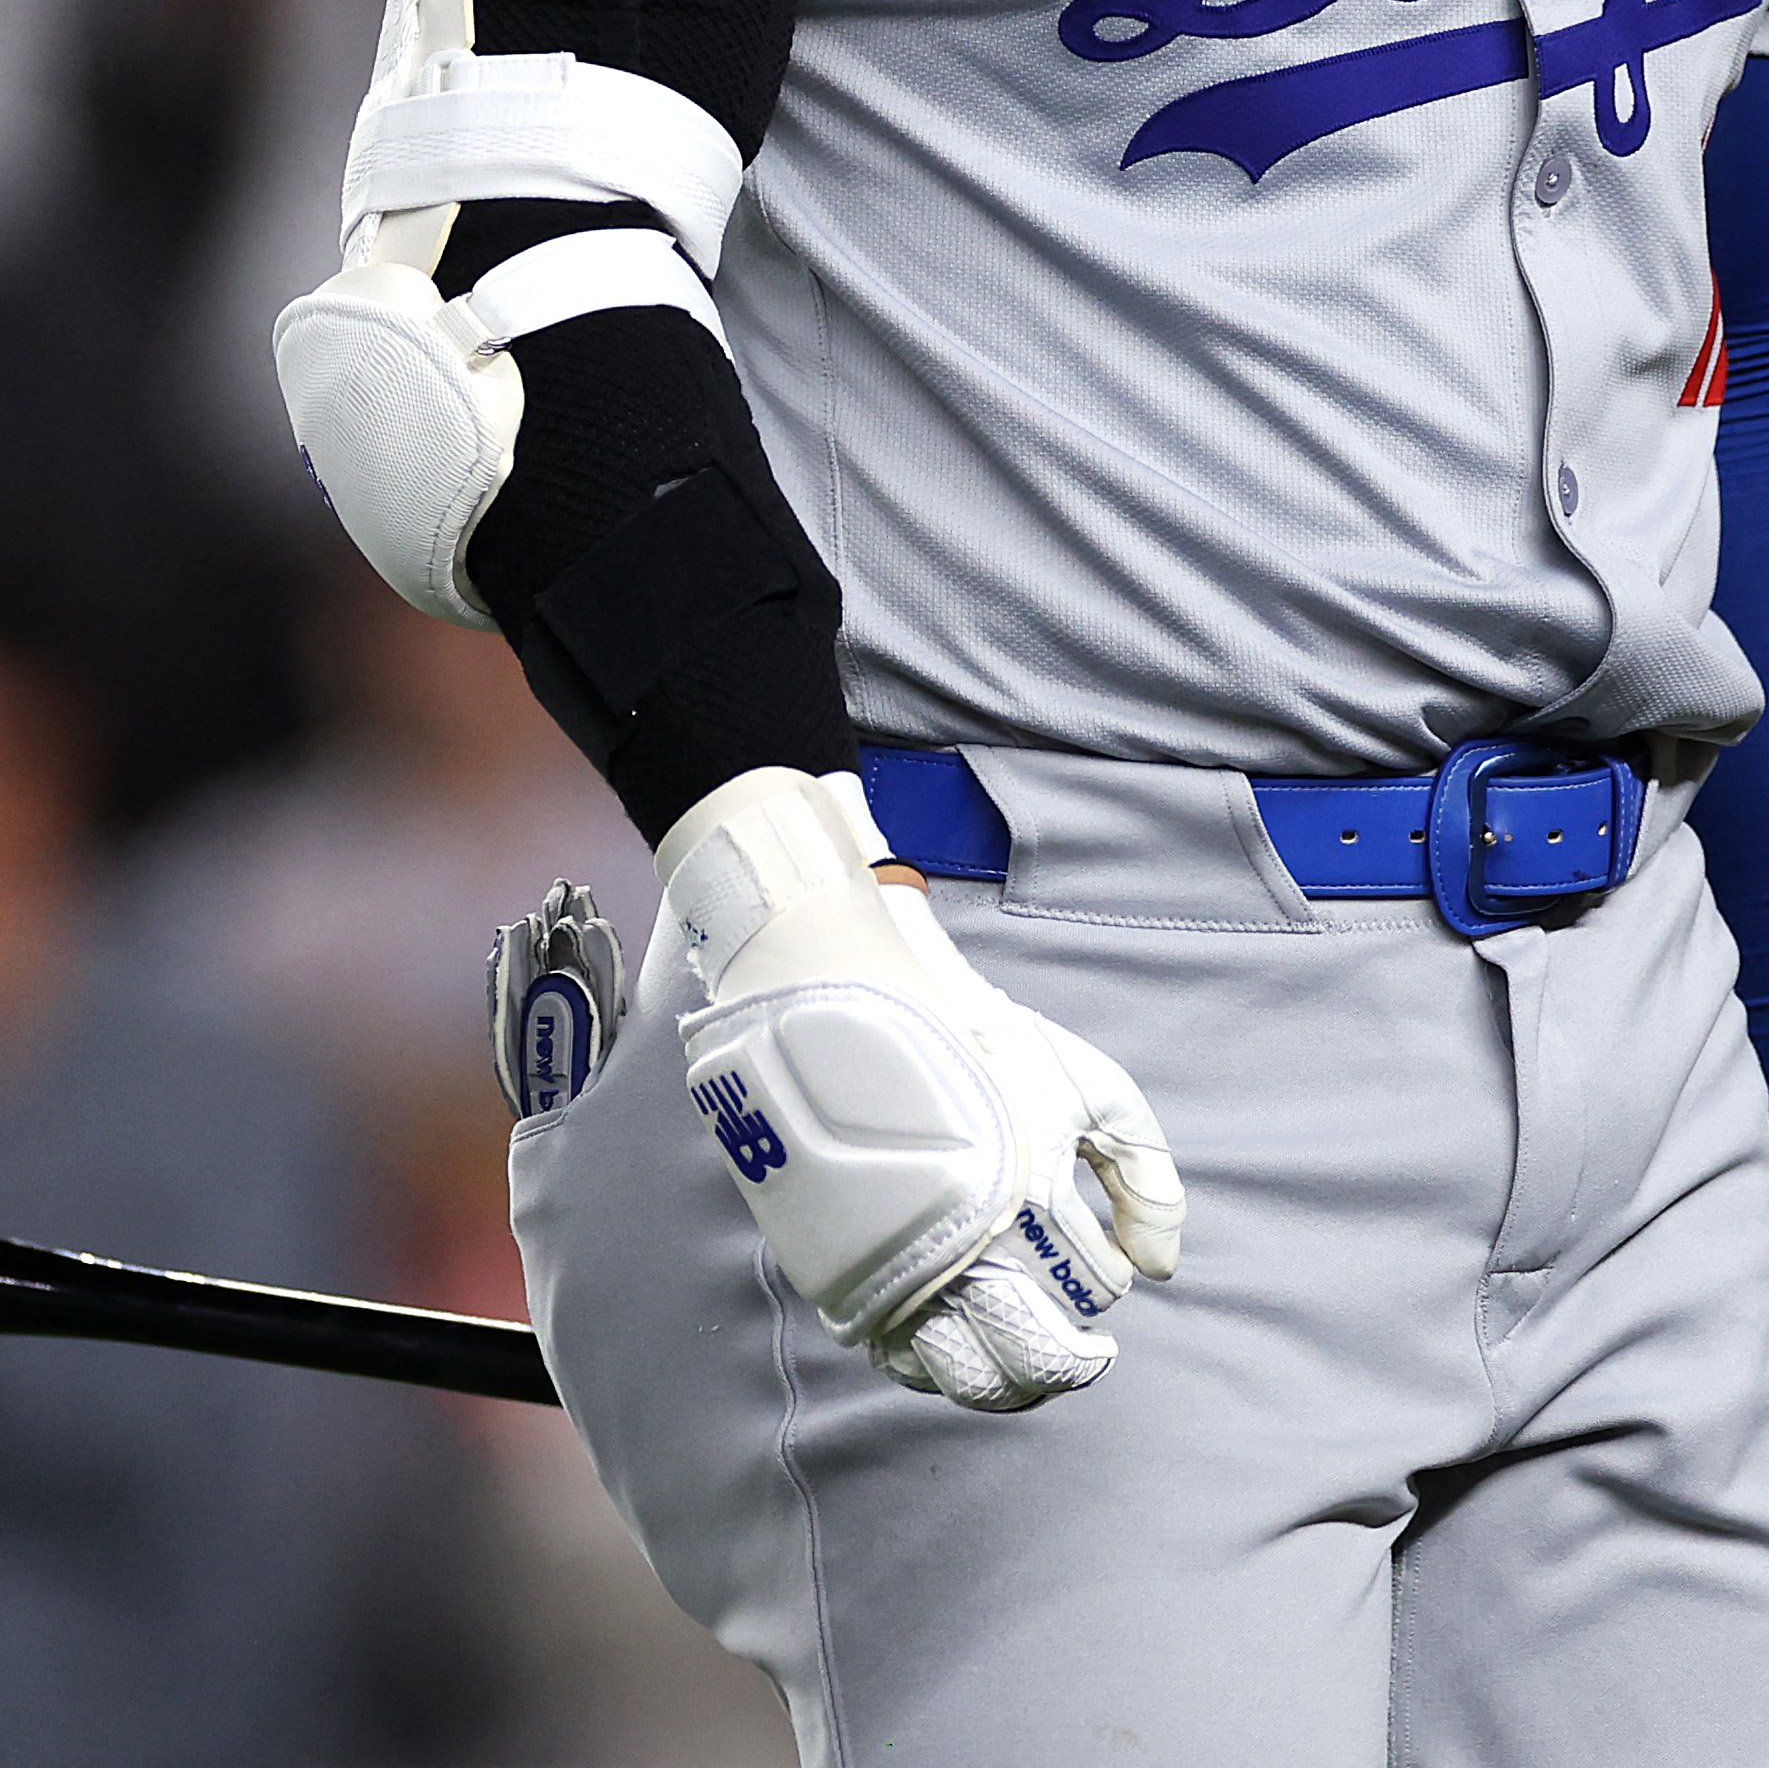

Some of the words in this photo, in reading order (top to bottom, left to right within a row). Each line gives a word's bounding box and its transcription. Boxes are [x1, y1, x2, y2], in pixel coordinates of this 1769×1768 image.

[536, 1016, 555, 1083] new
[1015, 1208, 1060, 1259] new
[1049, 1258, 1104, 1317] bala
